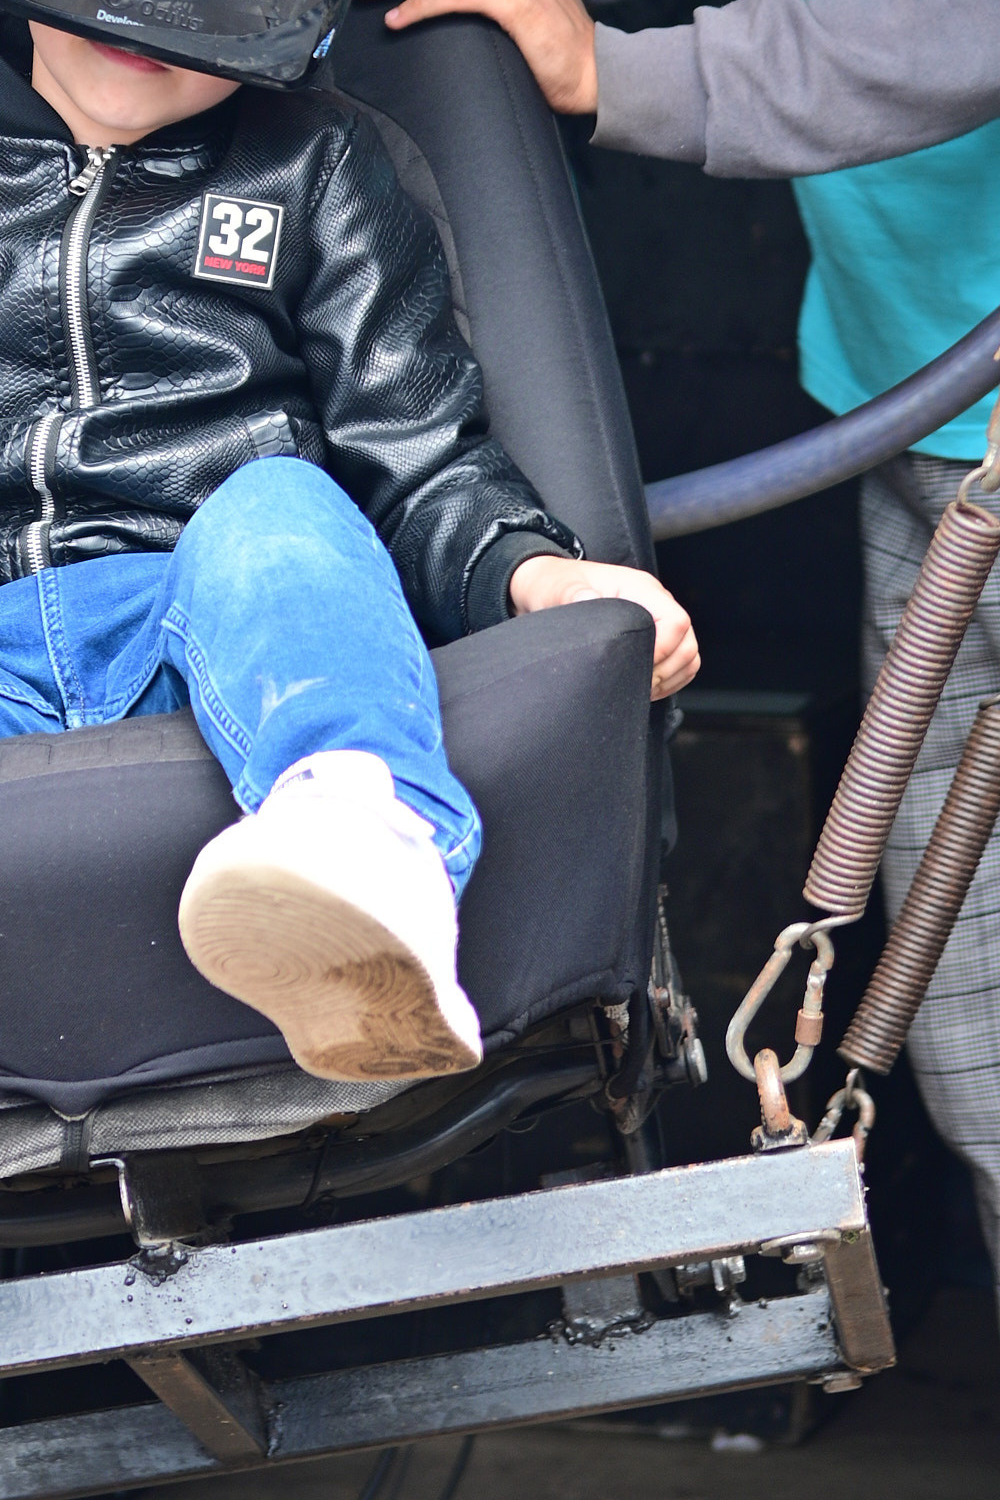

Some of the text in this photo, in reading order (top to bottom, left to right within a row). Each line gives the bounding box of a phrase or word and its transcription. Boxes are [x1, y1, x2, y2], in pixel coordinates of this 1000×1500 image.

[208, 201, 274, 263] 32
[203, 256, 267, 277] NEW YORK
